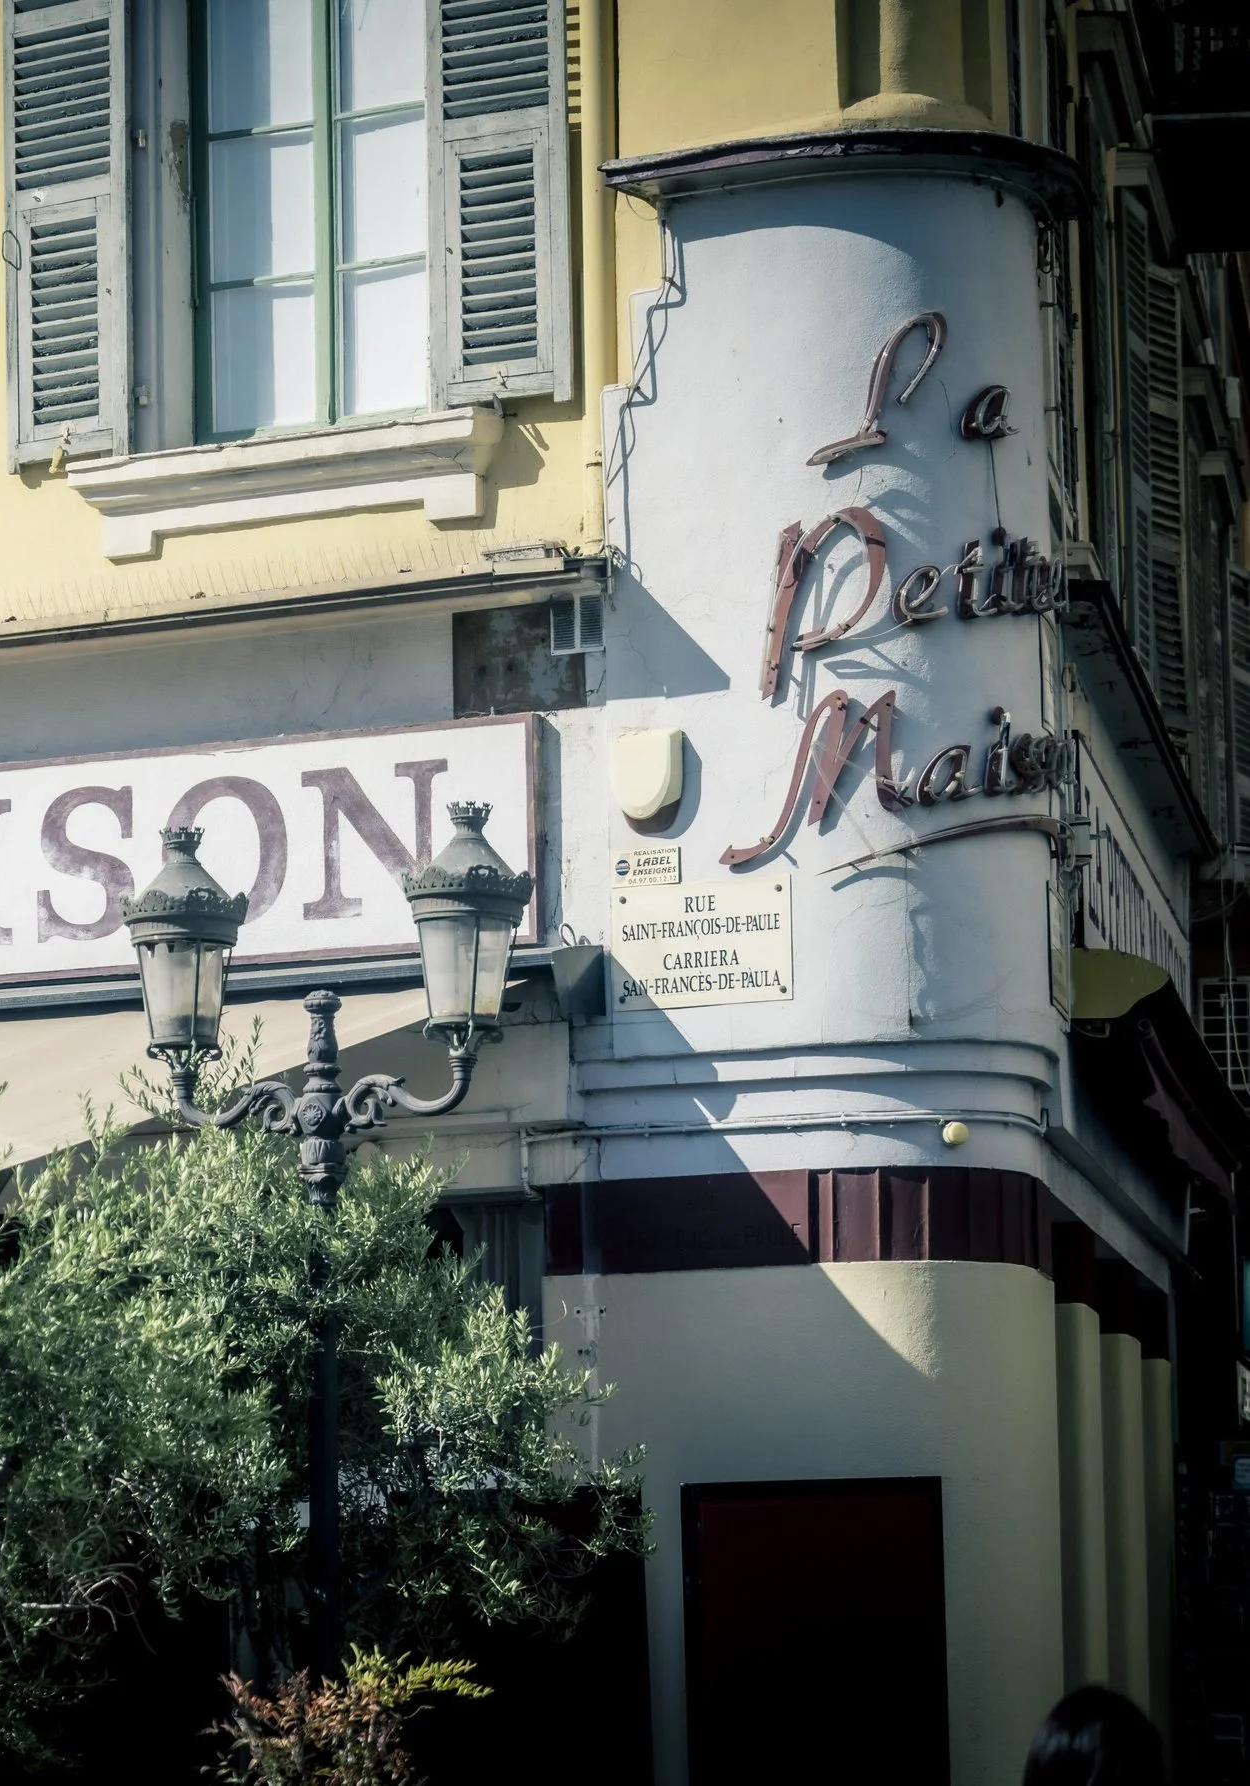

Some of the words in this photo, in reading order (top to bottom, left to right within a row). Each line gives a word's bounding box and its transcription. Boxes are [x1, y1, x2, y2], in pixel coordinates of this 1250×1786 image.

[806, 311, 1020, 466] La
[632, 866, 677, 876] ENSEIGNES
[637, 856, 671, 867] LABEL
[684, 895, 716, 913] RUE
[622, 912, 781, 941] SAINT-FRANÇOIS-DE-PAULE
[663, 949, 740, 970] CARRIERA
